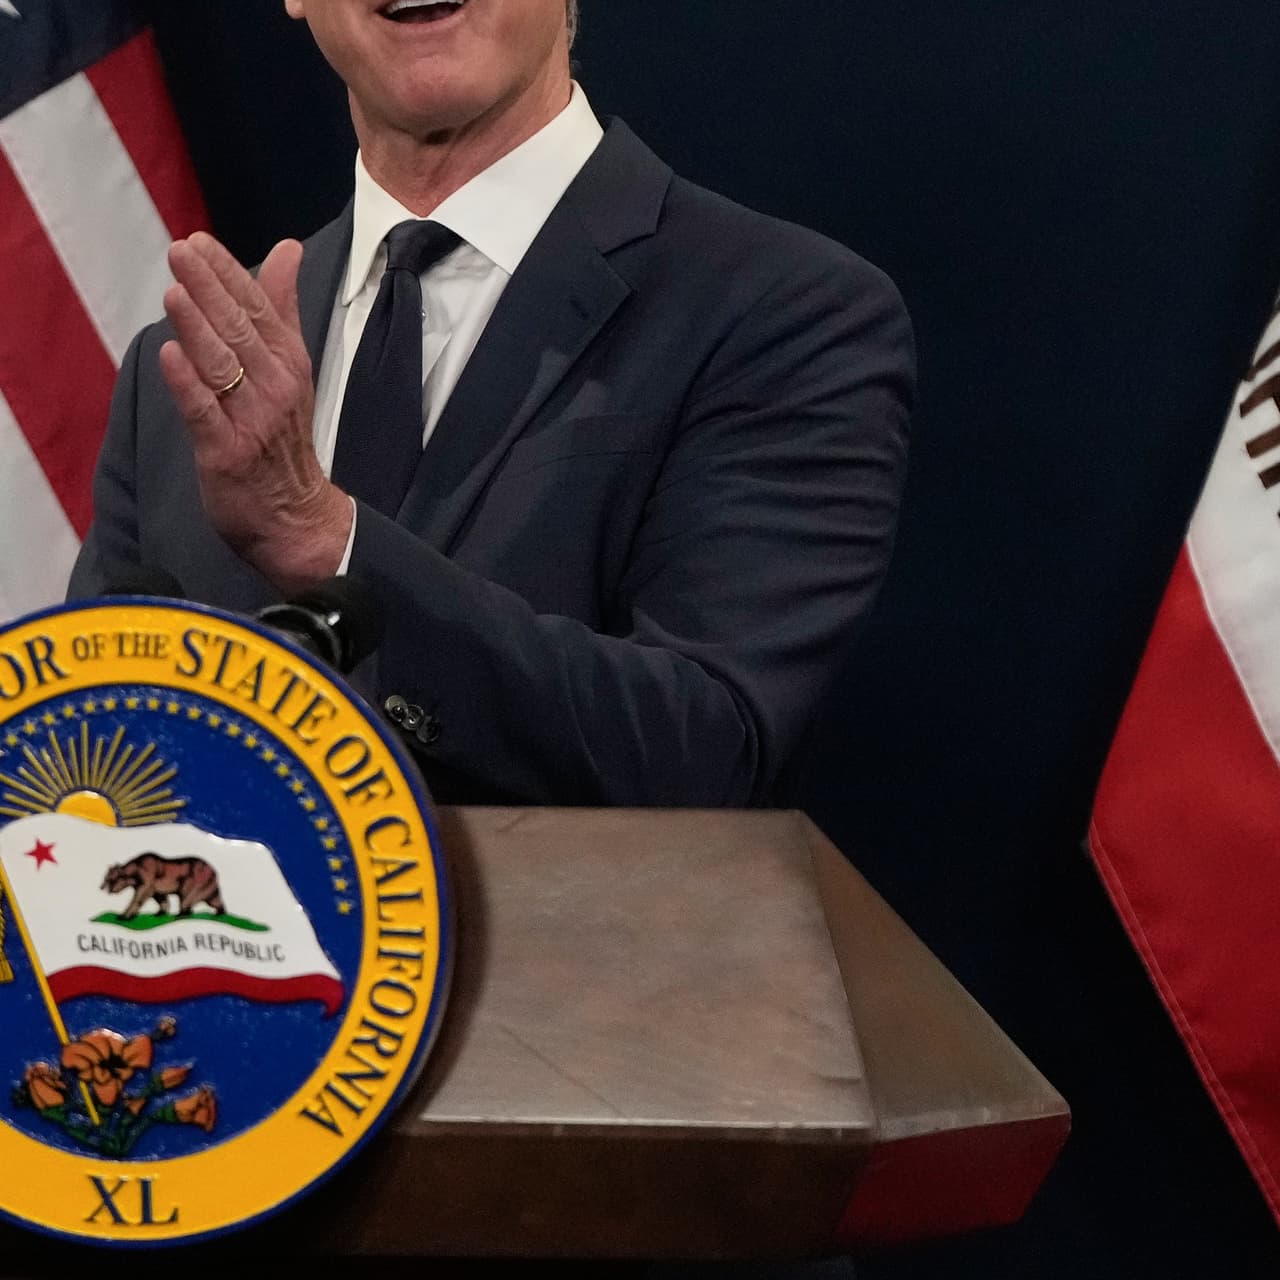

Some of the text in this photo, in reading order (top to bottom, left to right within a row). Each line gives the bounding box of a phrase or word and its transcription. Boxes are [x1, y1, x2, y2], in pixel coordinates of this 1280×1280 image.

[73, 635, 107, 662] OF
[114, 632, 169, 660] THE
[176, 628, 336, 744] STATE
[324, 732, 394, 807] OF
[77, 933, 286, 961] CALIFORNIA REPUBLIC
[298, 813, 426, 1139] CALIFORNIA
[84, 1174, 179, 1226] XL
